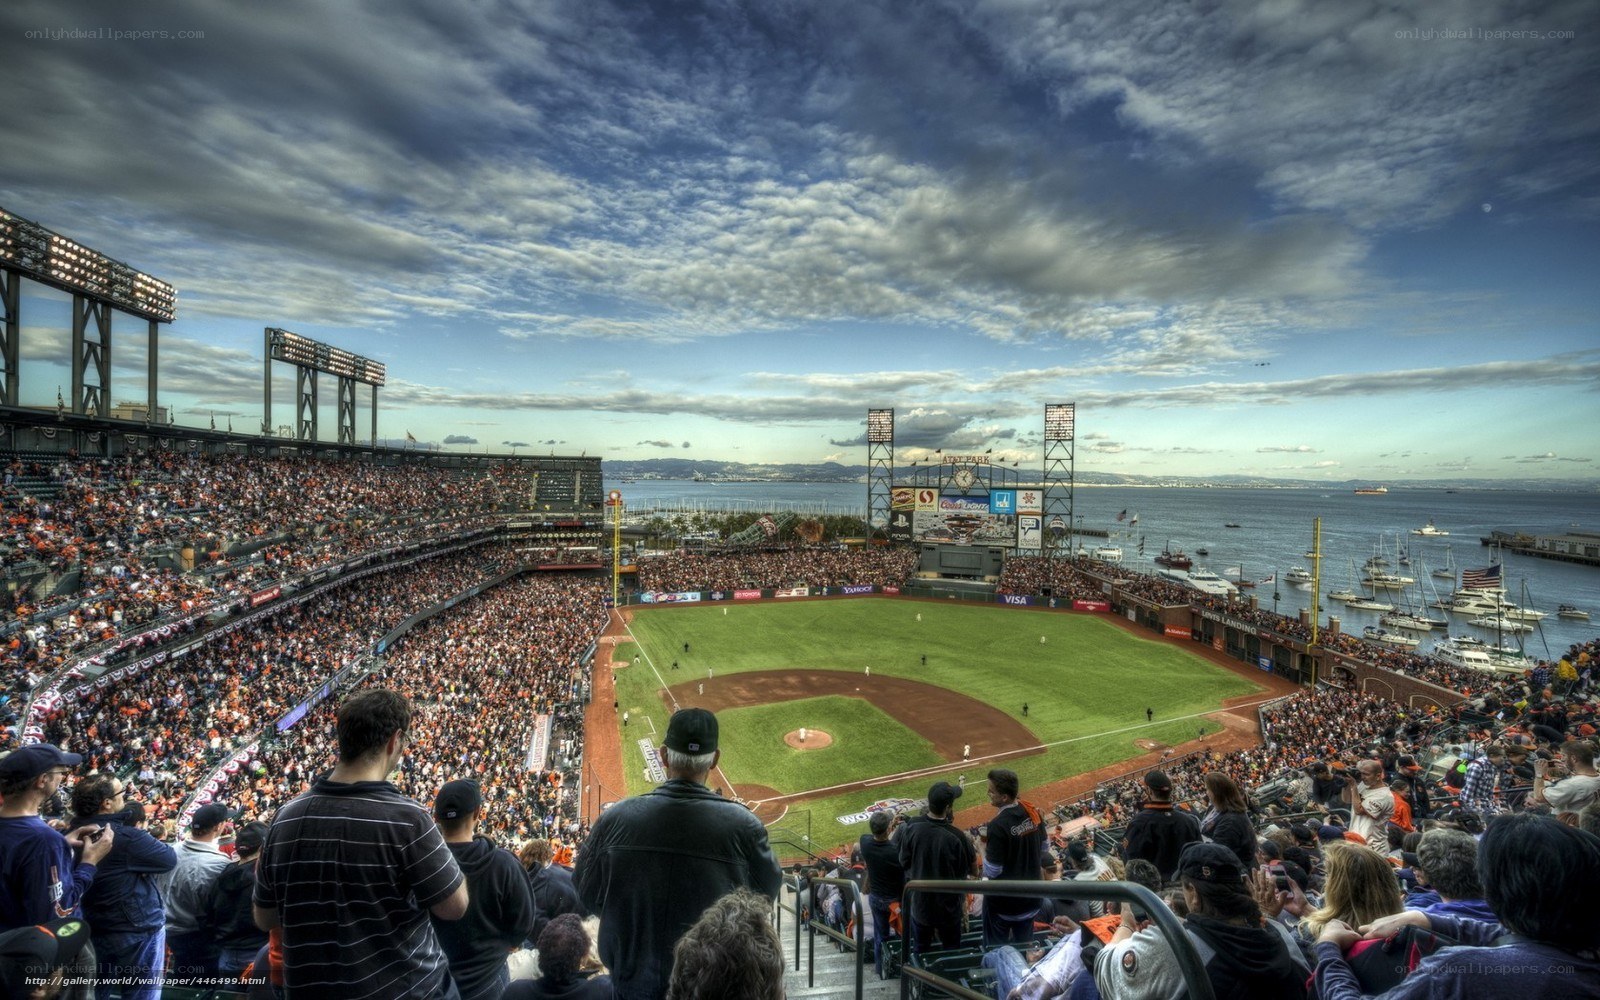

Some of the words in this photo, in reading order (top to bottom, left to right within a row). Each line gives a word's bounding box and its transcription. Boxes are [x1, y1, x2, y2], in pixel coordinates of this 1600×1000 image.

[967, 456, 990, 464] PARK
[1004, 595, 1027, 605] VISA
[1221, 616, 1257, 635] LANDING
